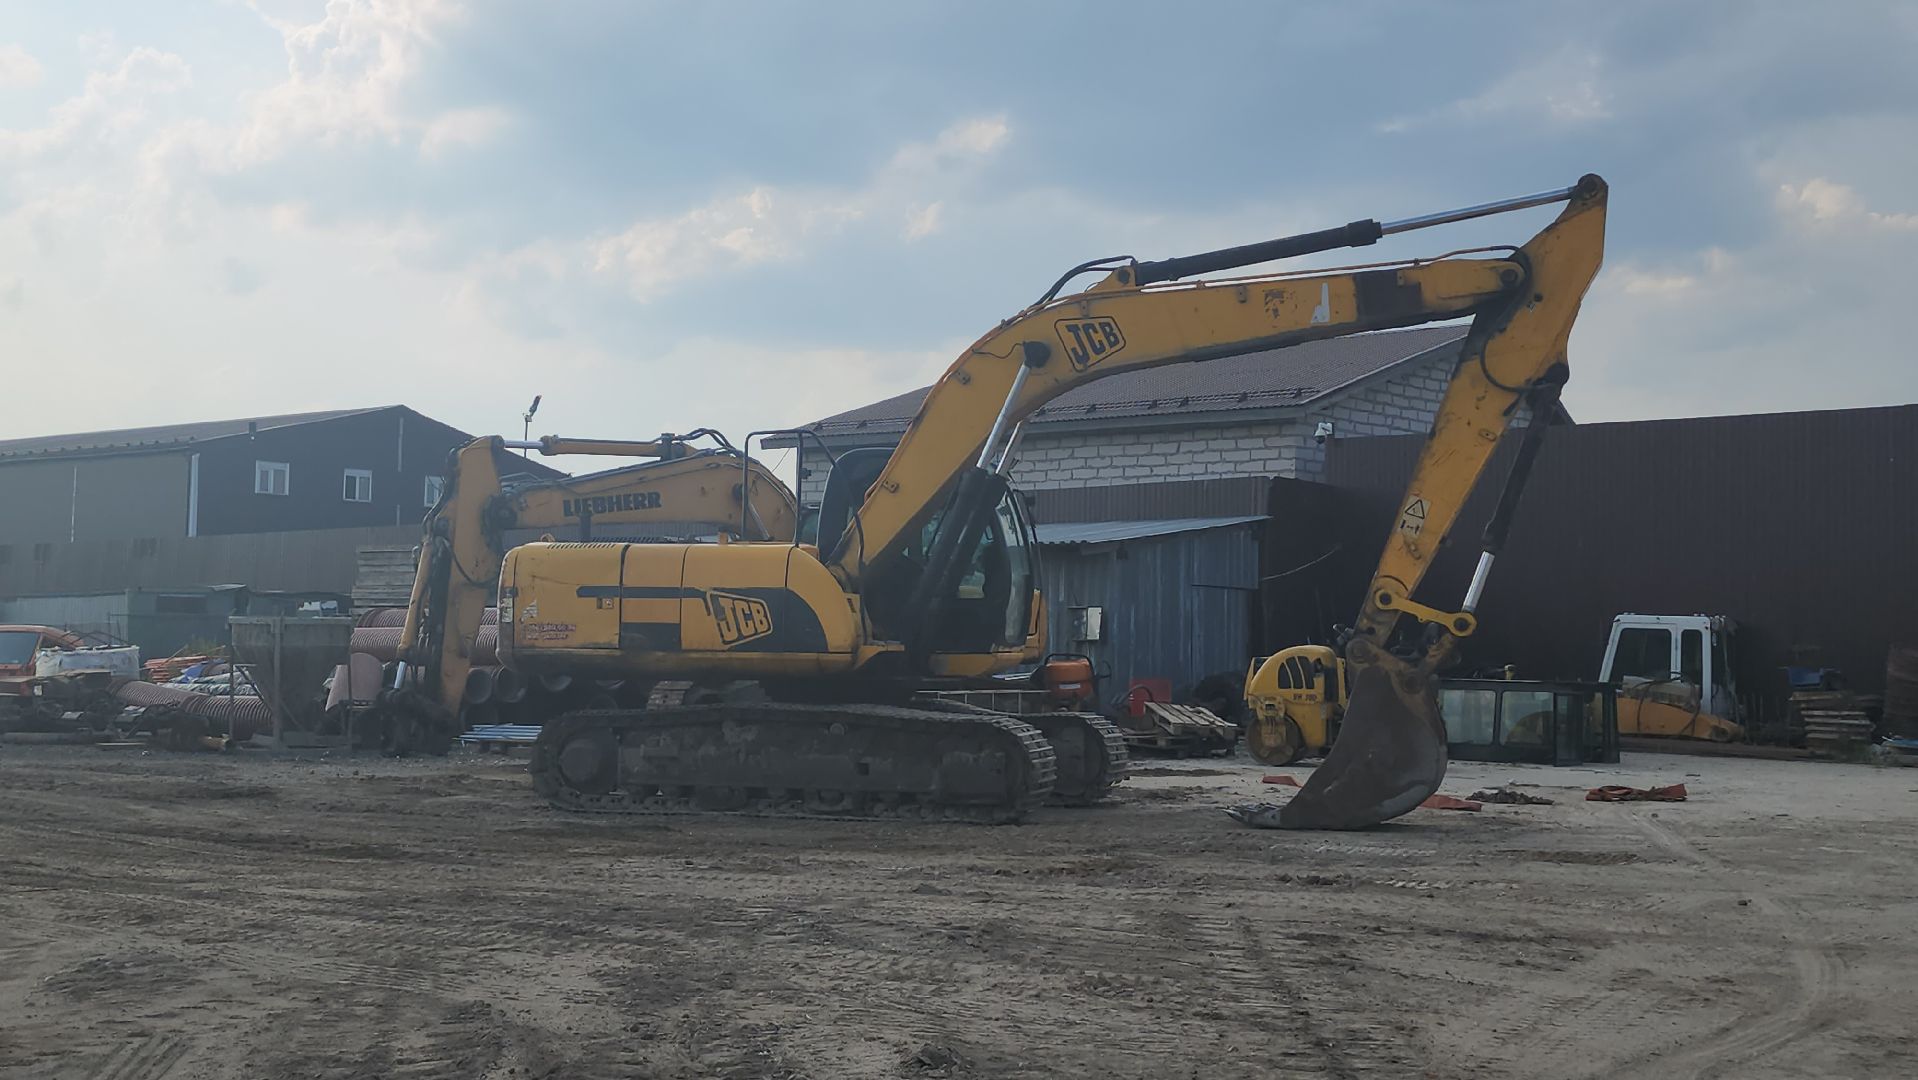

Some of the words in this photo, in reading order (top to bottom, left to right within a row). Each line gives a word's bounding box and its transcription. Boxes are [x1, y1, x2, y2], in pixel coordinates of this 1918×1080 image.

[1065, 322, 1120, 364] JCB
[563, 492, 662, 517] LIEBHERR
[718, 597, 770, 641] JCB
